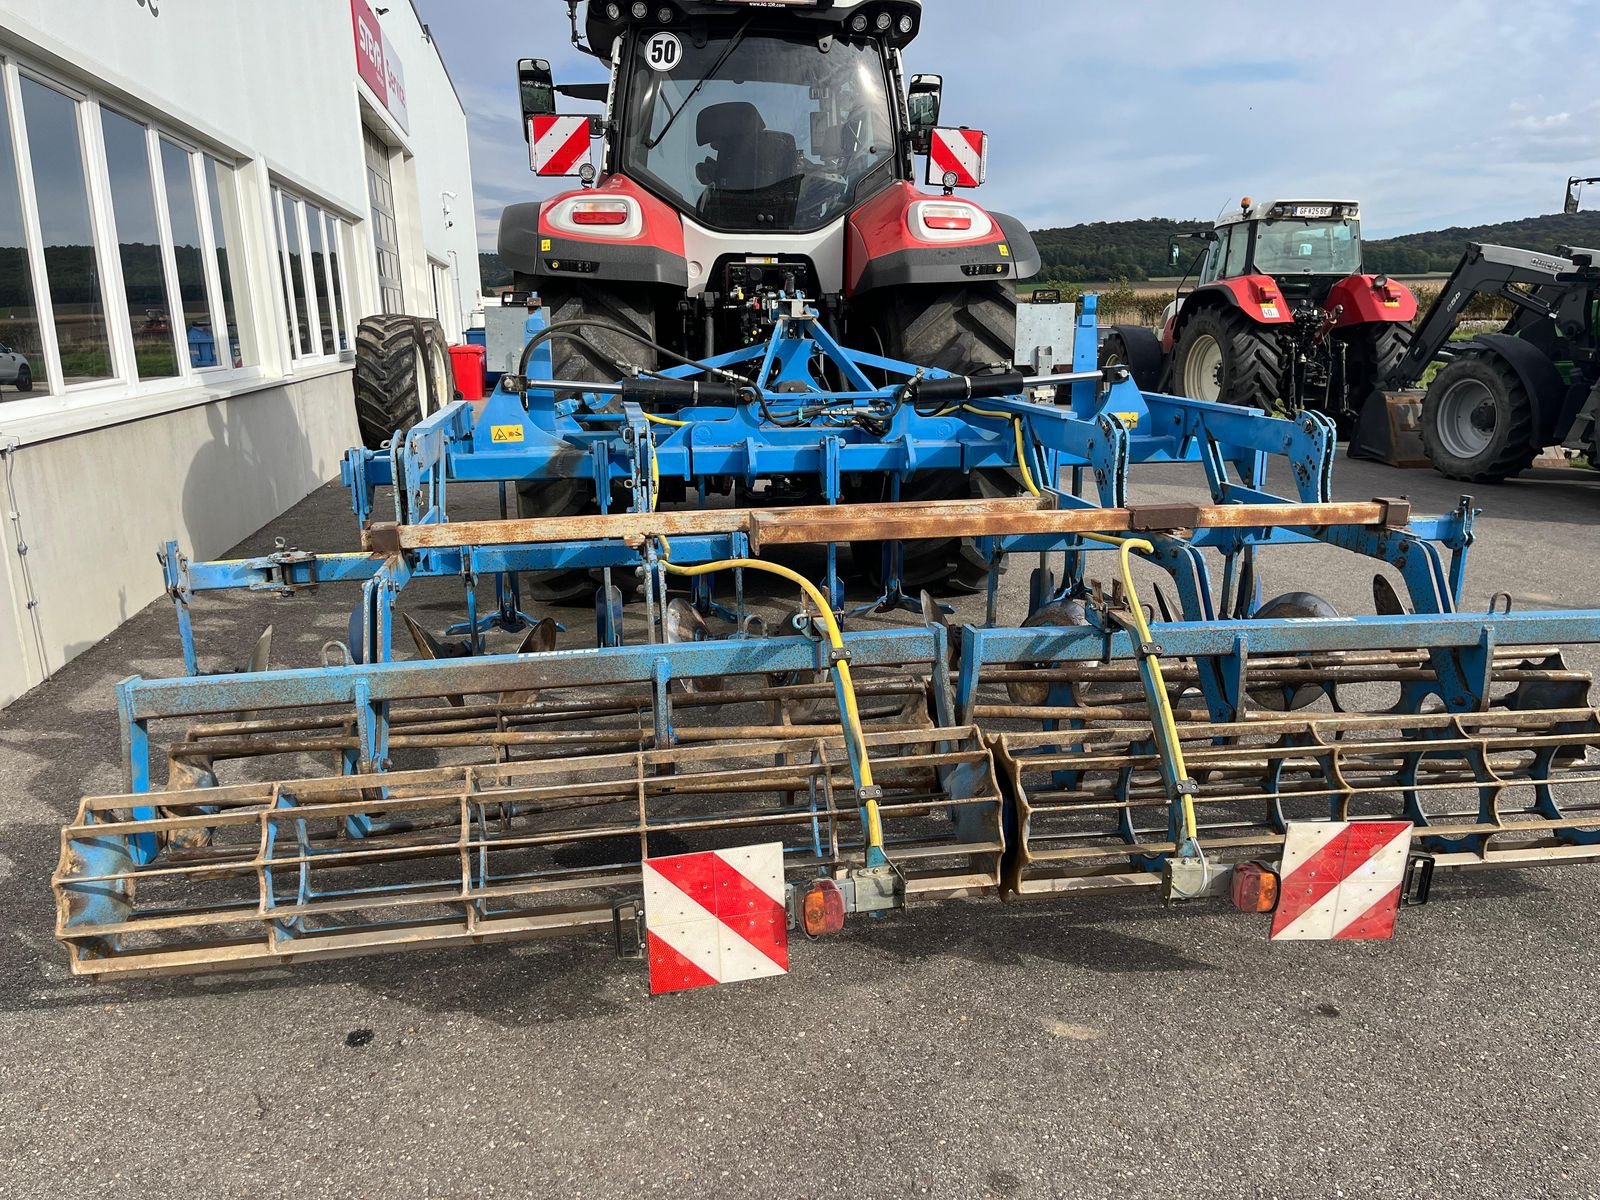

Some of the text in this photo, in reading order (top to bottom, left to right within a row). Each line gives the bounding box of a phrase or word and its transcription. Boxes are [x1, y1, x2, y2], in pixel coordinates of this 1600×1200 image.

[358, 15, 384, 77] STEYR
[651, 40, 676, 64] 50
[386, 58, 406, 109] Service
[1299, 207, 1308, 215] GF
